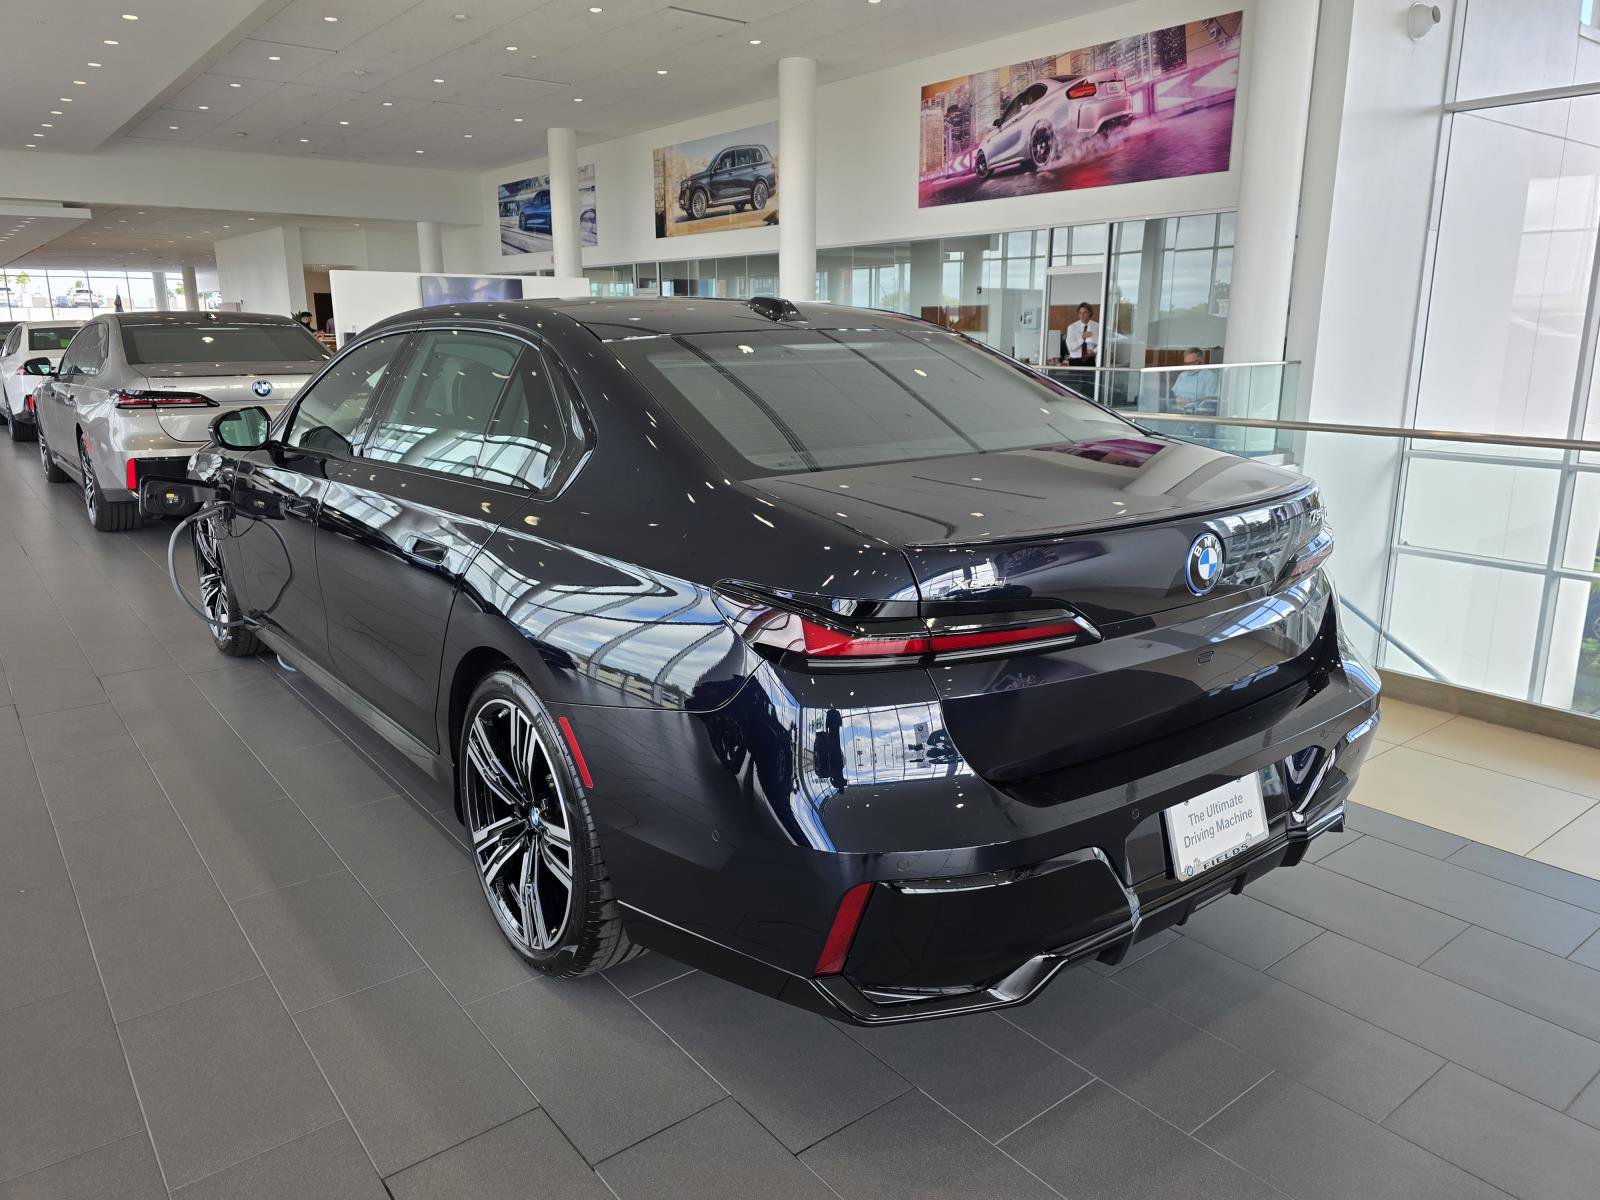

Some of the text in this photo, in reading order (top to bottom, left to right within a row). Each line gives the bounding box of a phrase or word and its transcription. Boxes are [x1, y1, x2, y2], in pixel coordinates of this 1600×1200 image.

[1188, 794, 1243, 826] The Ultimate
[1183, 808, 1253, 849] Driving Machine
[1203, 843, 1249, 870] FIELDS
